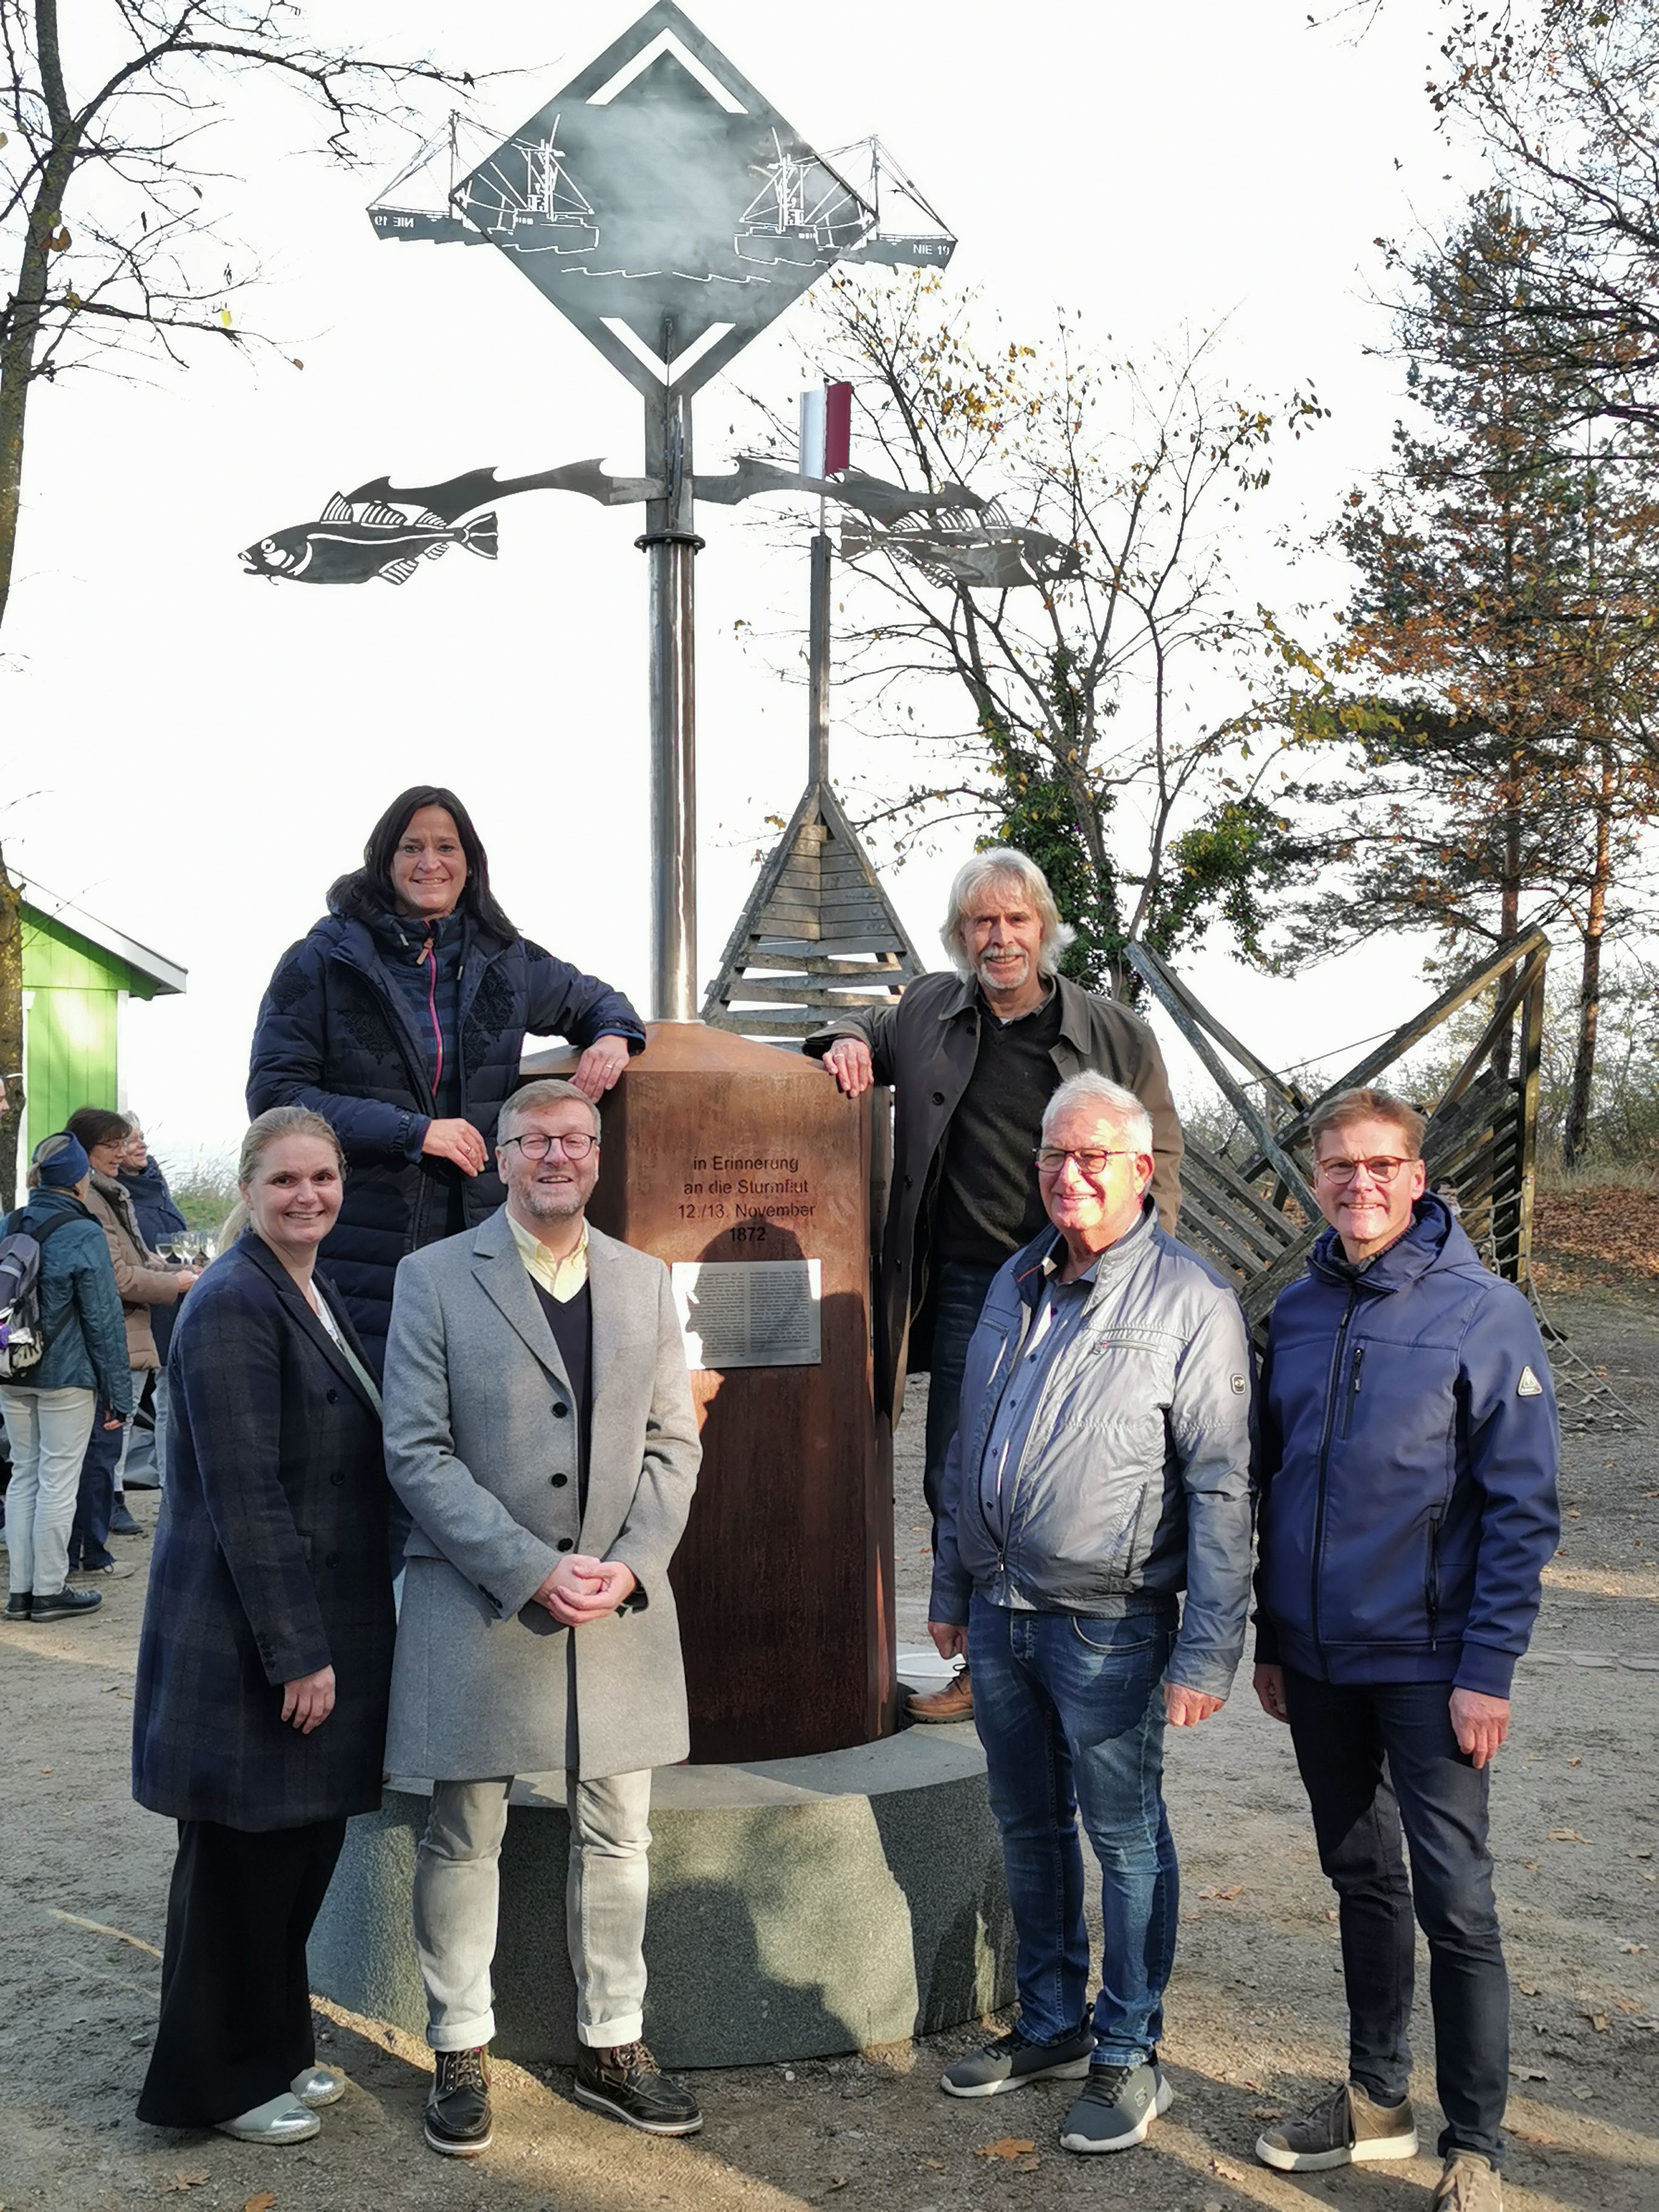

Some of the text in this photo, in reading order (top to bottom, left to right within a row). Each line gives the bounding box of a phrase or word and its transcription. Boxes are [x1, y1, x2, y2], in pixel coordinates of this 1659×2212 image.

[913, 243, 950, 256] NIE 19
[693, 1156, 799, 1173] in Erinnerung
[683, 1179, 809, 1195] an die Sturmflut
[678, 1203, 816, 1219] 12./13. November
[729, 1226, 766, 1242] 1872
